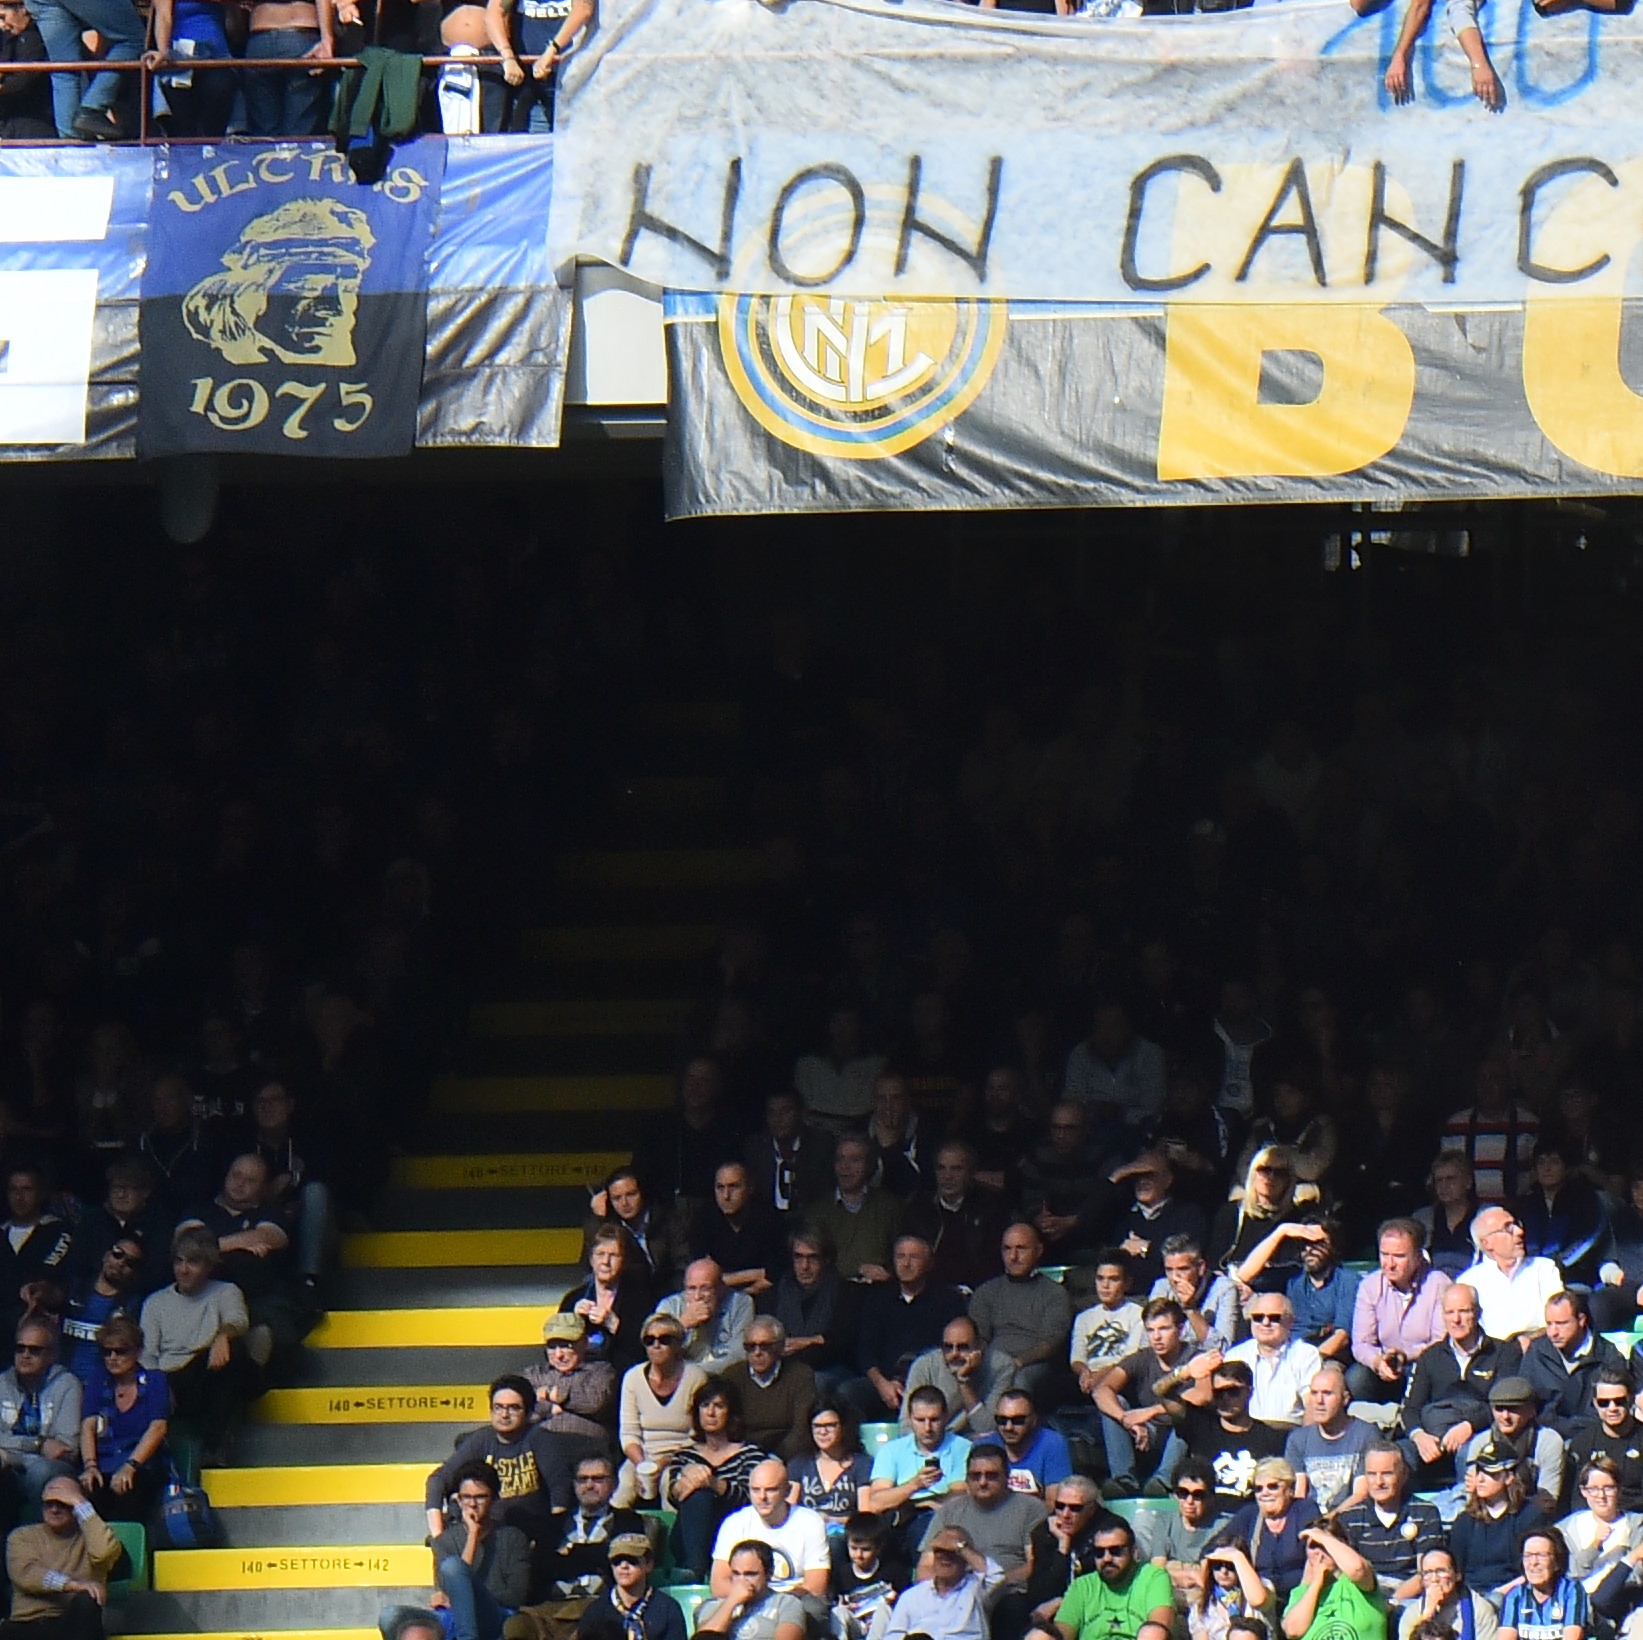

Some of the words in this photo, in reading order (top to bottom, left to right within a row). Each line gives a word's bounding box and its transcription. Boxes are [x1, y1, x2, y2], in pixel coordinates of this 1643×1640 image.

[167, 149, 430, 214] ULTRS
[188, 376, 375, 440] 1975
[328, 1399, 350, 1412] 140
[366, 1397, 439, 1409] SETTORE
[453, 1397, 474, 1409] 142
[242, 1561, 262, 1573] 140
[278, 1558, 350, 1570] SETTORE
[368, 1559, 389, 1571] 142
